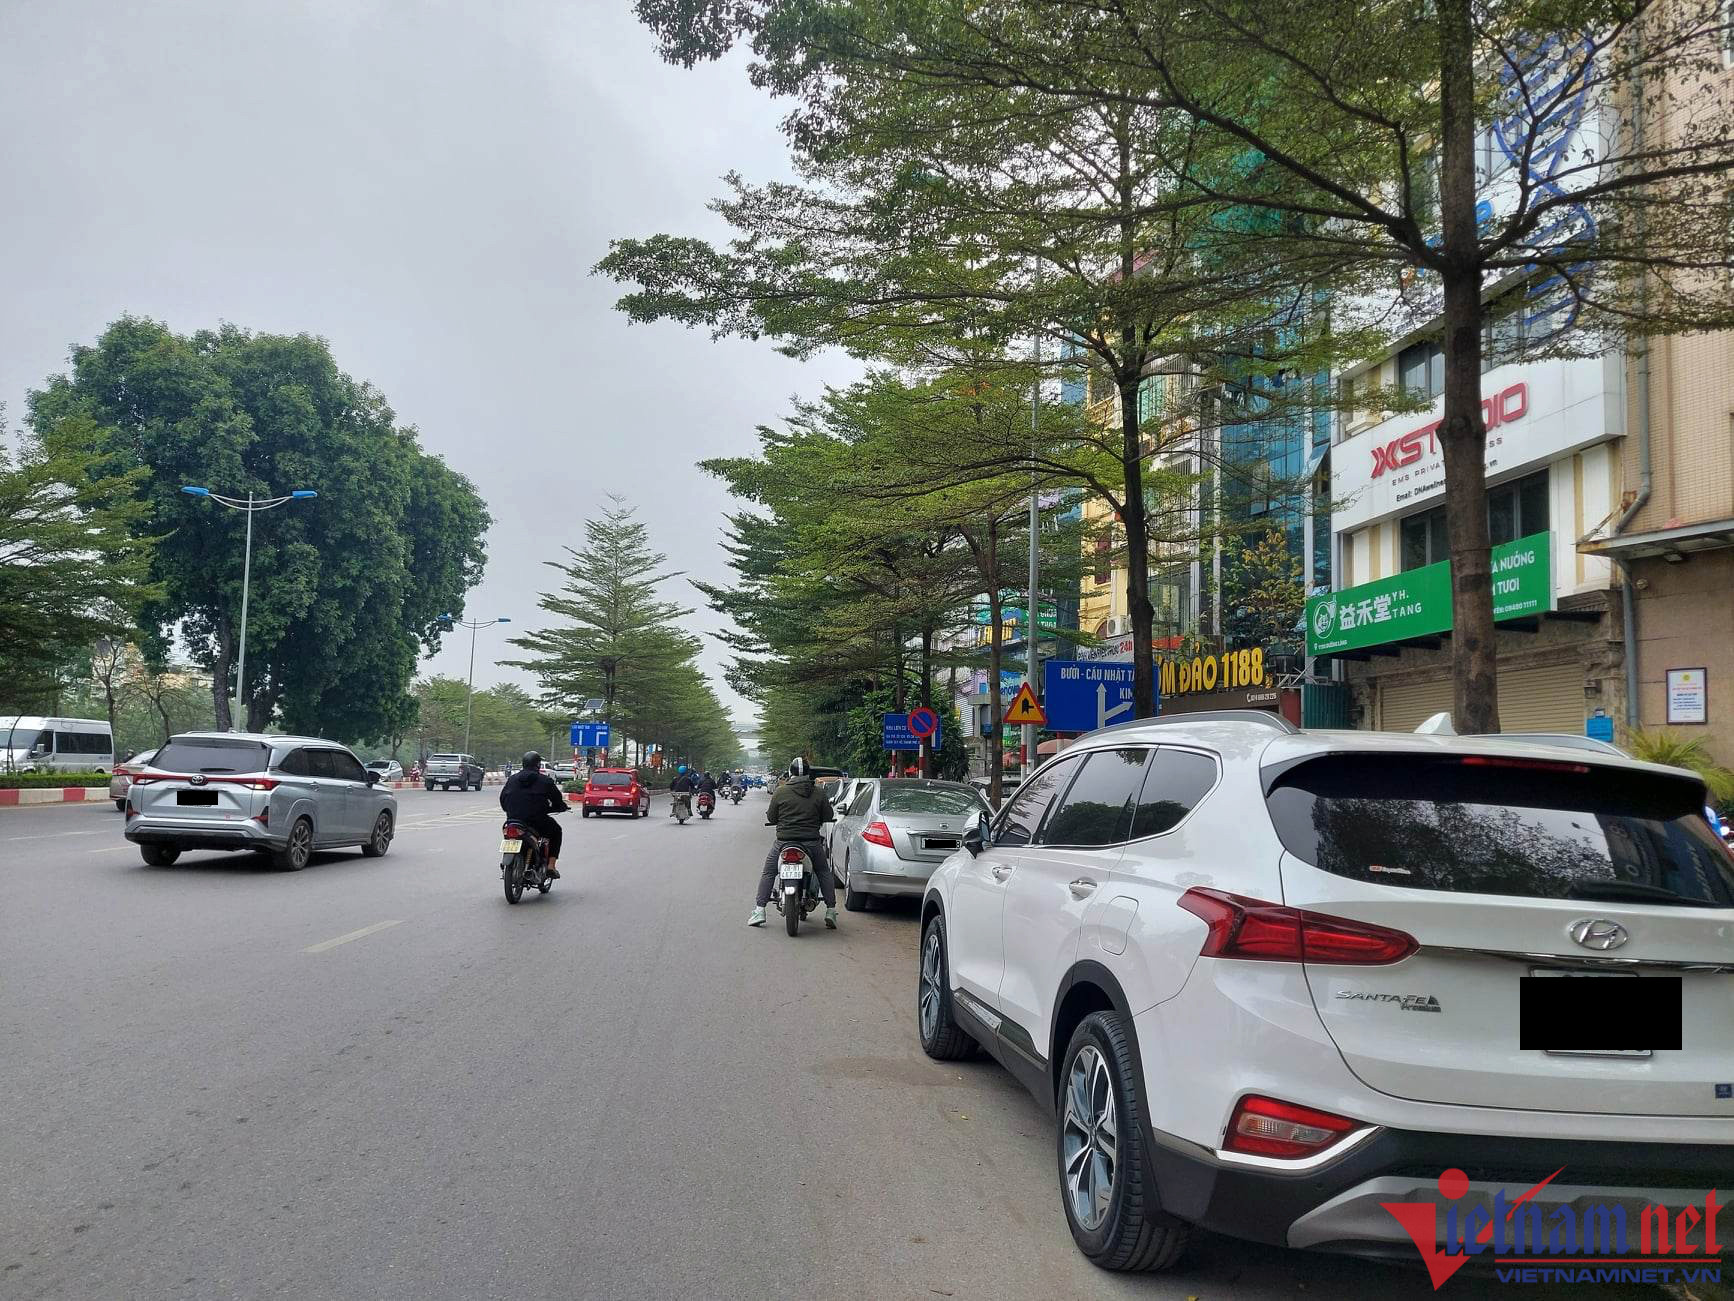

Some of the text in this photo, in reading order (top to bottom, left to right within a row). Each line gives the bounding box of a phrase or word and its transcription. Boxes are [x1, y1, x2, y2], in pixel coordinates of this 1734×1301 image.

[1392, 474, 1410, 486] EMS
[1396, 491, 1413, 502] Email:
[1339, 593, 1392, 631] 益禾堂
[1392, 602, 1422, 618] TANG
[1221, 647, 1264, 689] 1188
